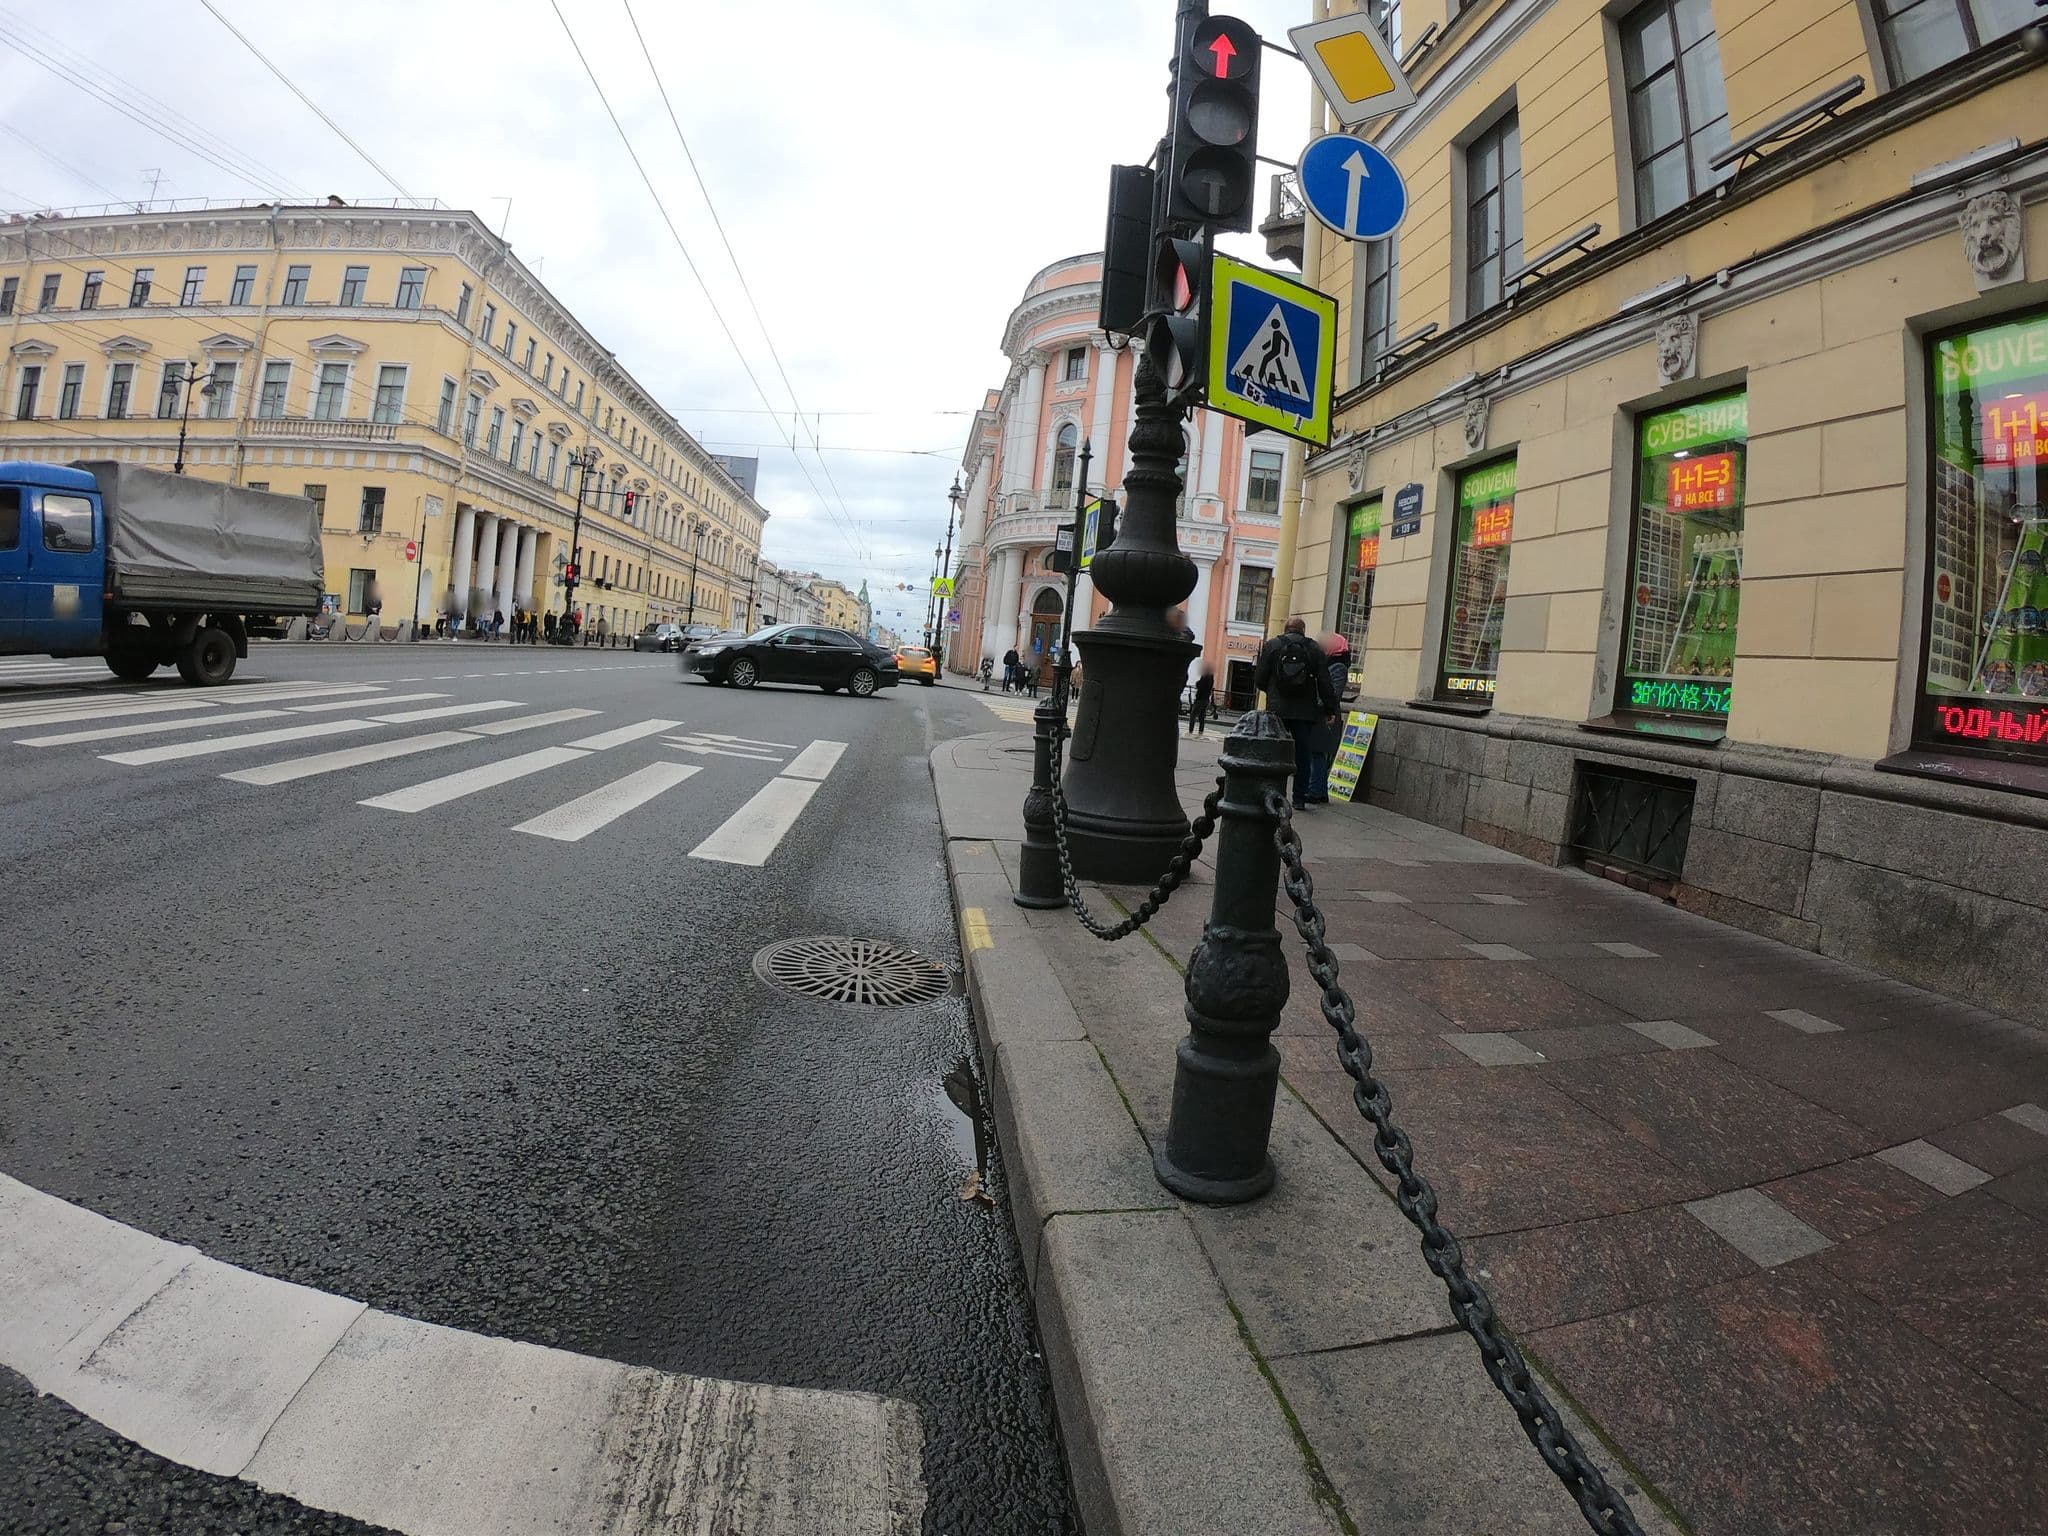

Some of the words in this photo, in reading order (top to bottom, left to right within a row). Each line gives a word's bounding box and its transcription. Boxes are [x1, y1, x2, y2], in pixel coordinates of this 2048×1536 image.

[1647, 401, 1747, 448] СУВЕНИР
[1988, 401, 2048, 440] 1+1
[2013, 440, 2032, 458] НА
[1463, 468, 1517, 500] SOUVENI
[1671, 458, 1730, 492] 1+1=3
[1685, 493, 1697, 505] НА
[1698, 489, 1714, 504] ВСЕ
[1477, 508, 1510, 534] 1+1=3
